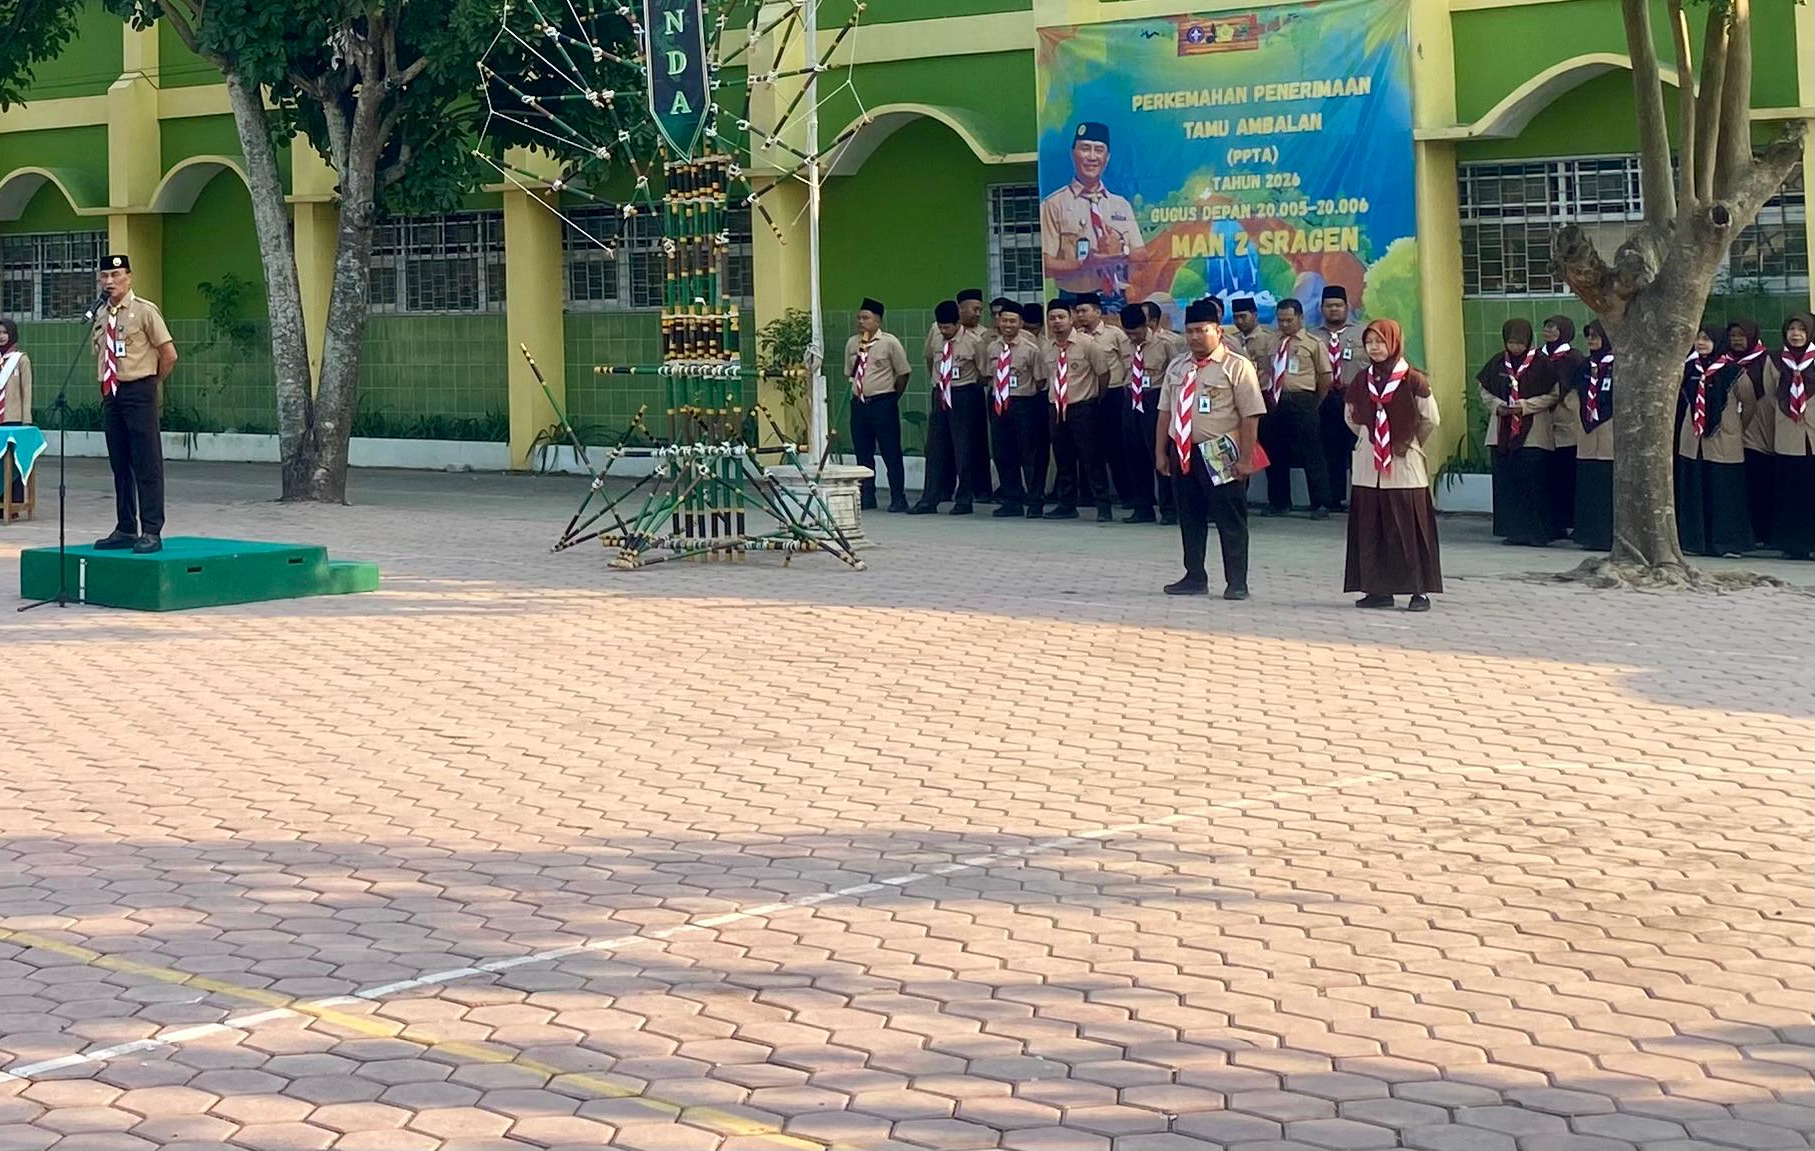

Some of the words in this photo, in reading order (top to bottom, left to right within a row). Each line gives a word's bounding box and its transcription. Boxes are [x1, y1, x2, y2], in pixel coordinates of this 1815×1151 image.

[1131, 86, 1248, 112] PERKEMAHAN
[1253, 76, 1372, 102] PENERIMAAN
[1183, 120, 1230, 139] TAMU
[1236, 112, 1323, 136] AMBALAN
[1226, 145, 1279, 167] (PPTA)
[1211, 174, 1261, 191] TAHUN
[1265, 172, 1301, 188] 2026
[1150, 205, 1197, 223] GUGUS
[1202, 203, 1251, 221] DEPAN
[1171, 232, 1225, 258] MAN
[1234, 231, 1250, 256] 2
[1258, 226, 1359, 255] SRAGEN
